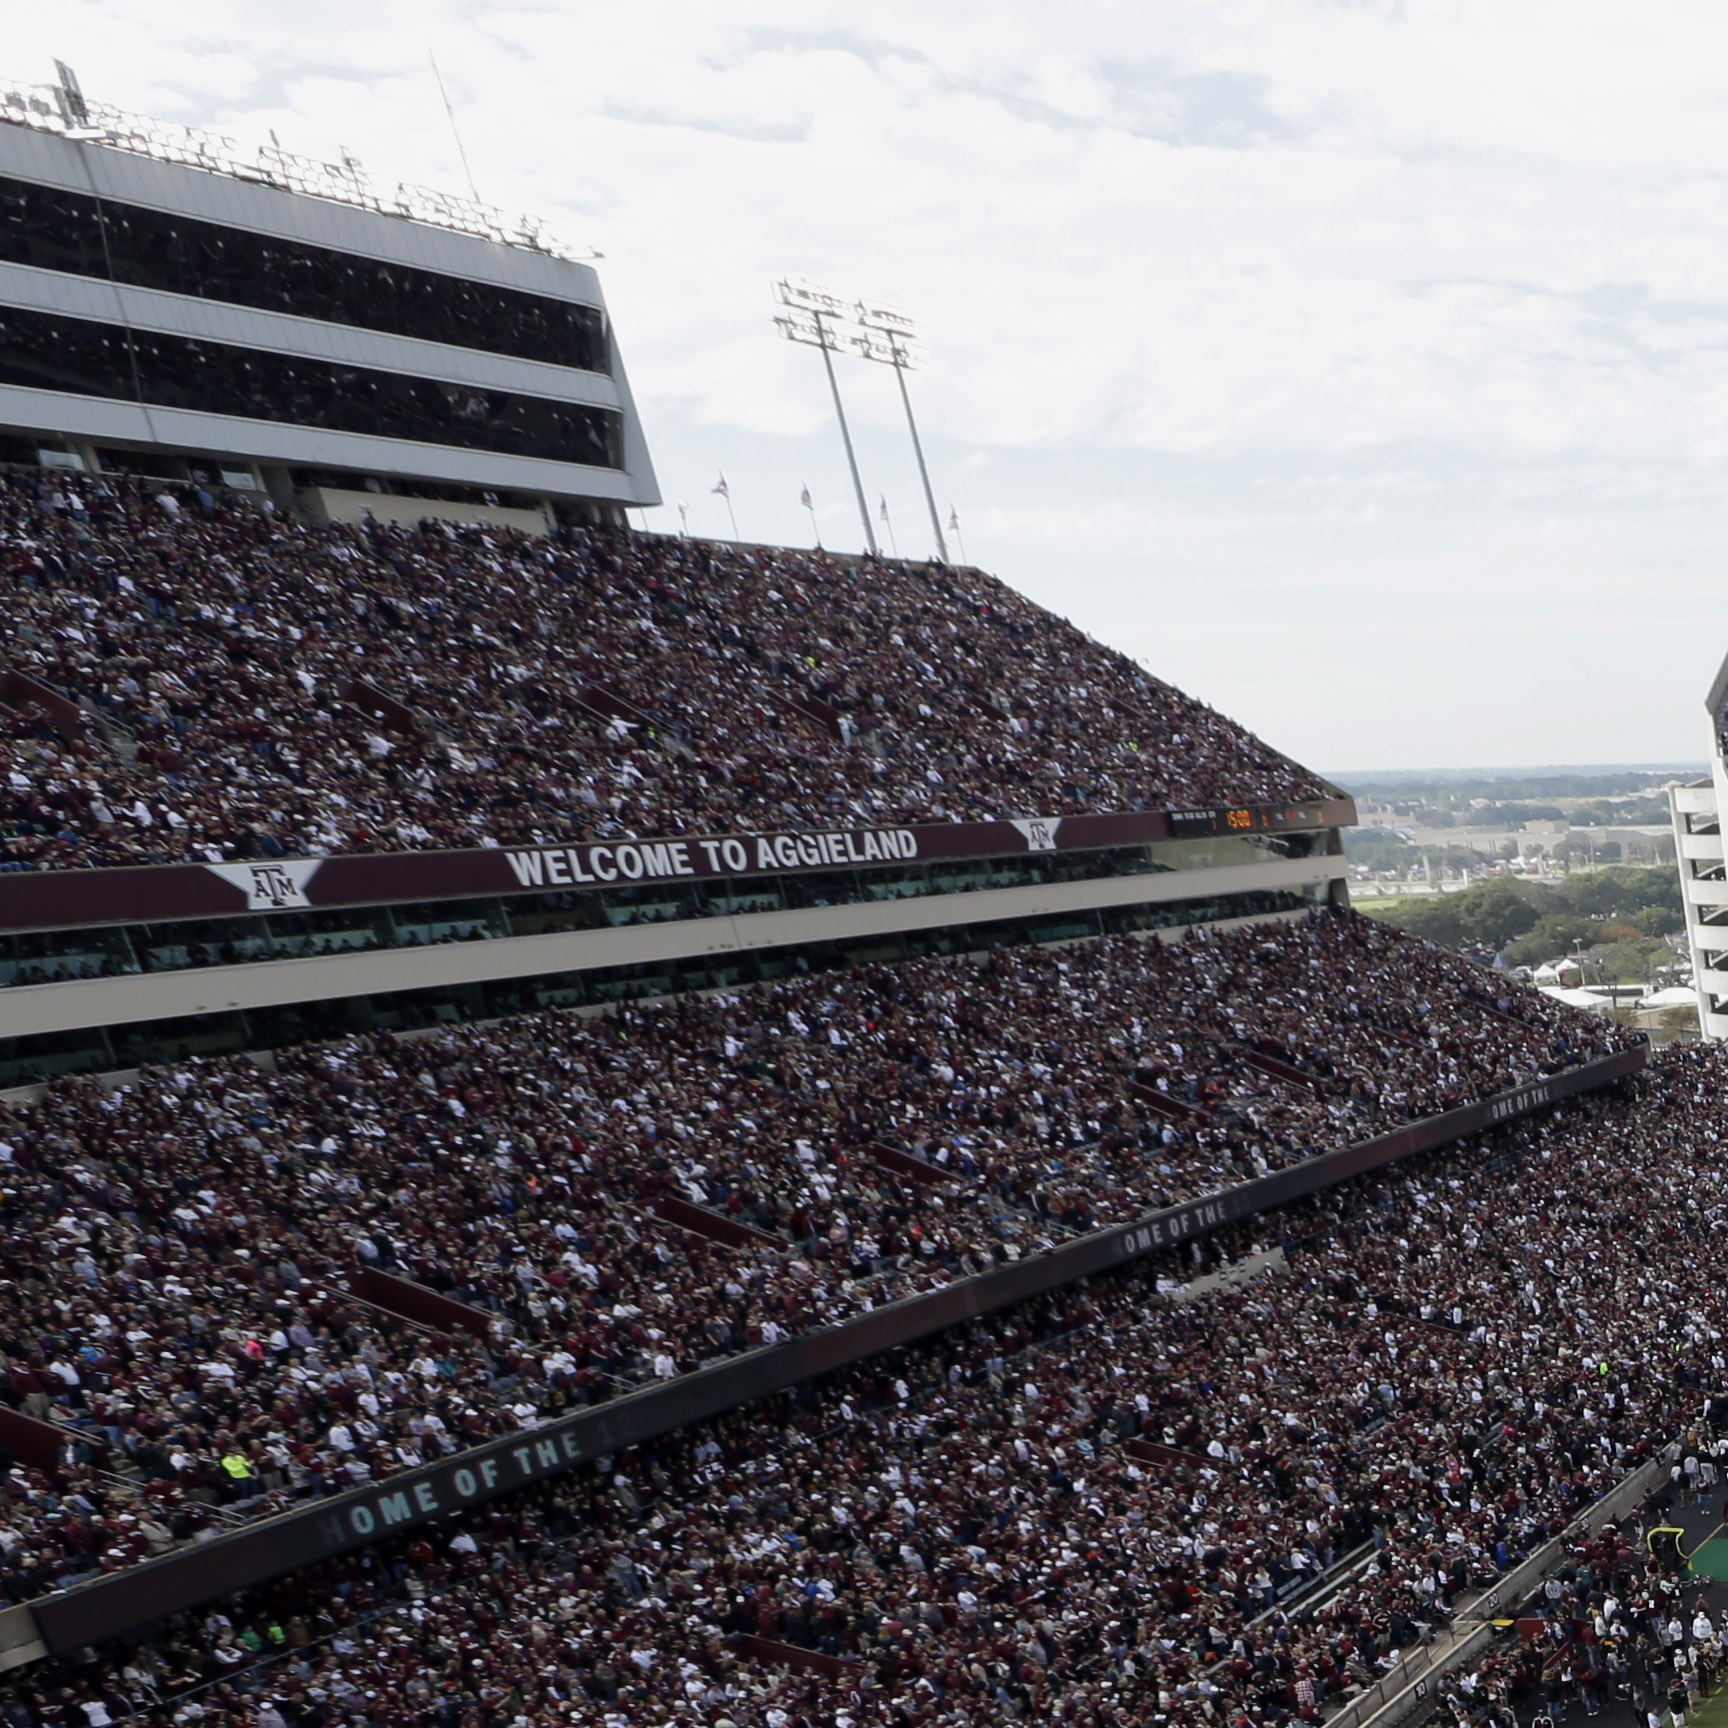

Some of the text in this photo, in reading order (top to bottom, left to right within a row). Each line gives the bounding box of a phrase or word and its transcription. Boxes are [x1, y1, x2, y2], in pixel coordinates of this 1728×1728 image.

[505, 830, 918, 886] WELCOME TO AGGIELAND
[1169, 1214, 1188, 1237] OF
[1195, 1202, 1226, 1227] THE
[454, 1459, 499, 1497] OF
[513, 1431, 583, 1475] THE
